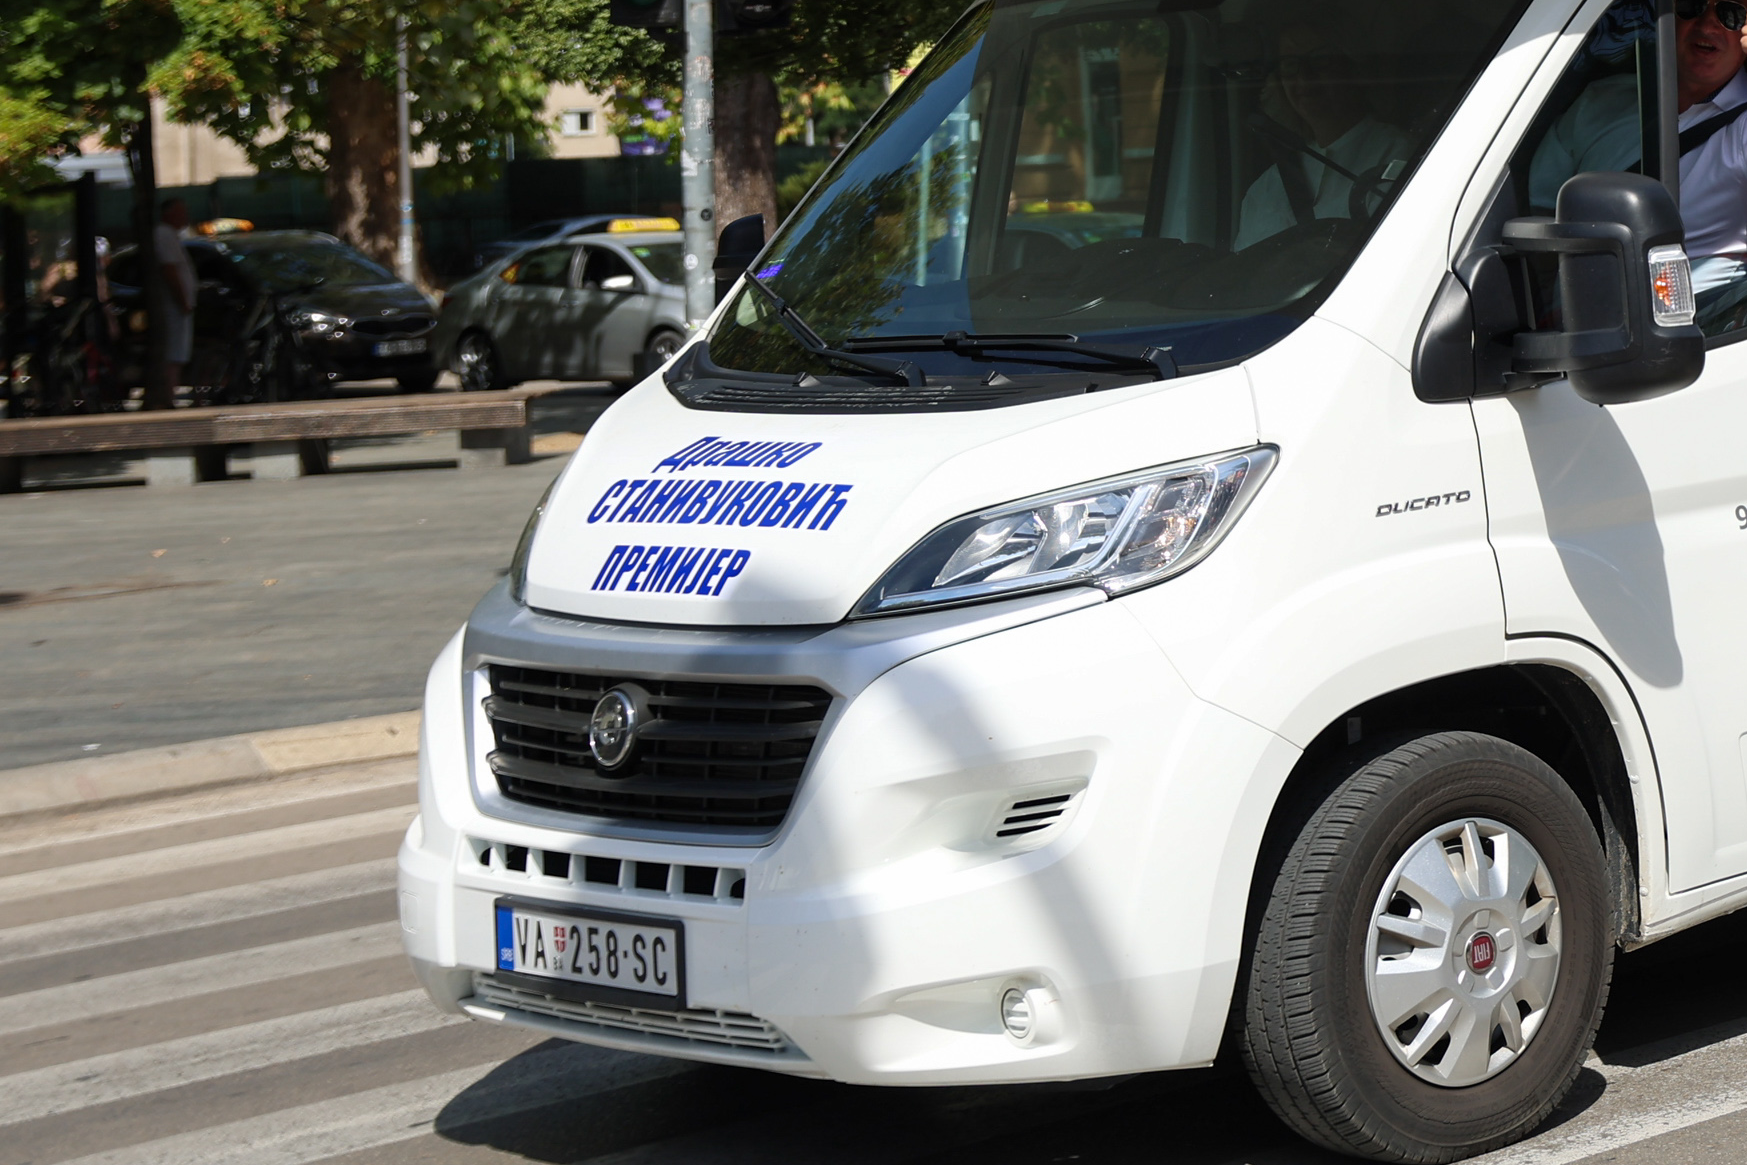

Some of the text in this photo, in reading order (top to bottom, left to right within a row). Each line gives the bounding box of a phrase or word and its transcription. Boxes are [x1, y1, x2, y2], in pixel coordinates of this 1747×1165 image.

[650, 436, 823, 474] Драшко
[586, 479, 854, 531] СТАНИВУКОВИЋ
[1375, 490, 1471, 517] DUCATO
[590, 545, 751, 596] ПРЕМИЈЕР
[515, 917, 548, 970] VA
[1473, 941, 1491, 964] FIAT
